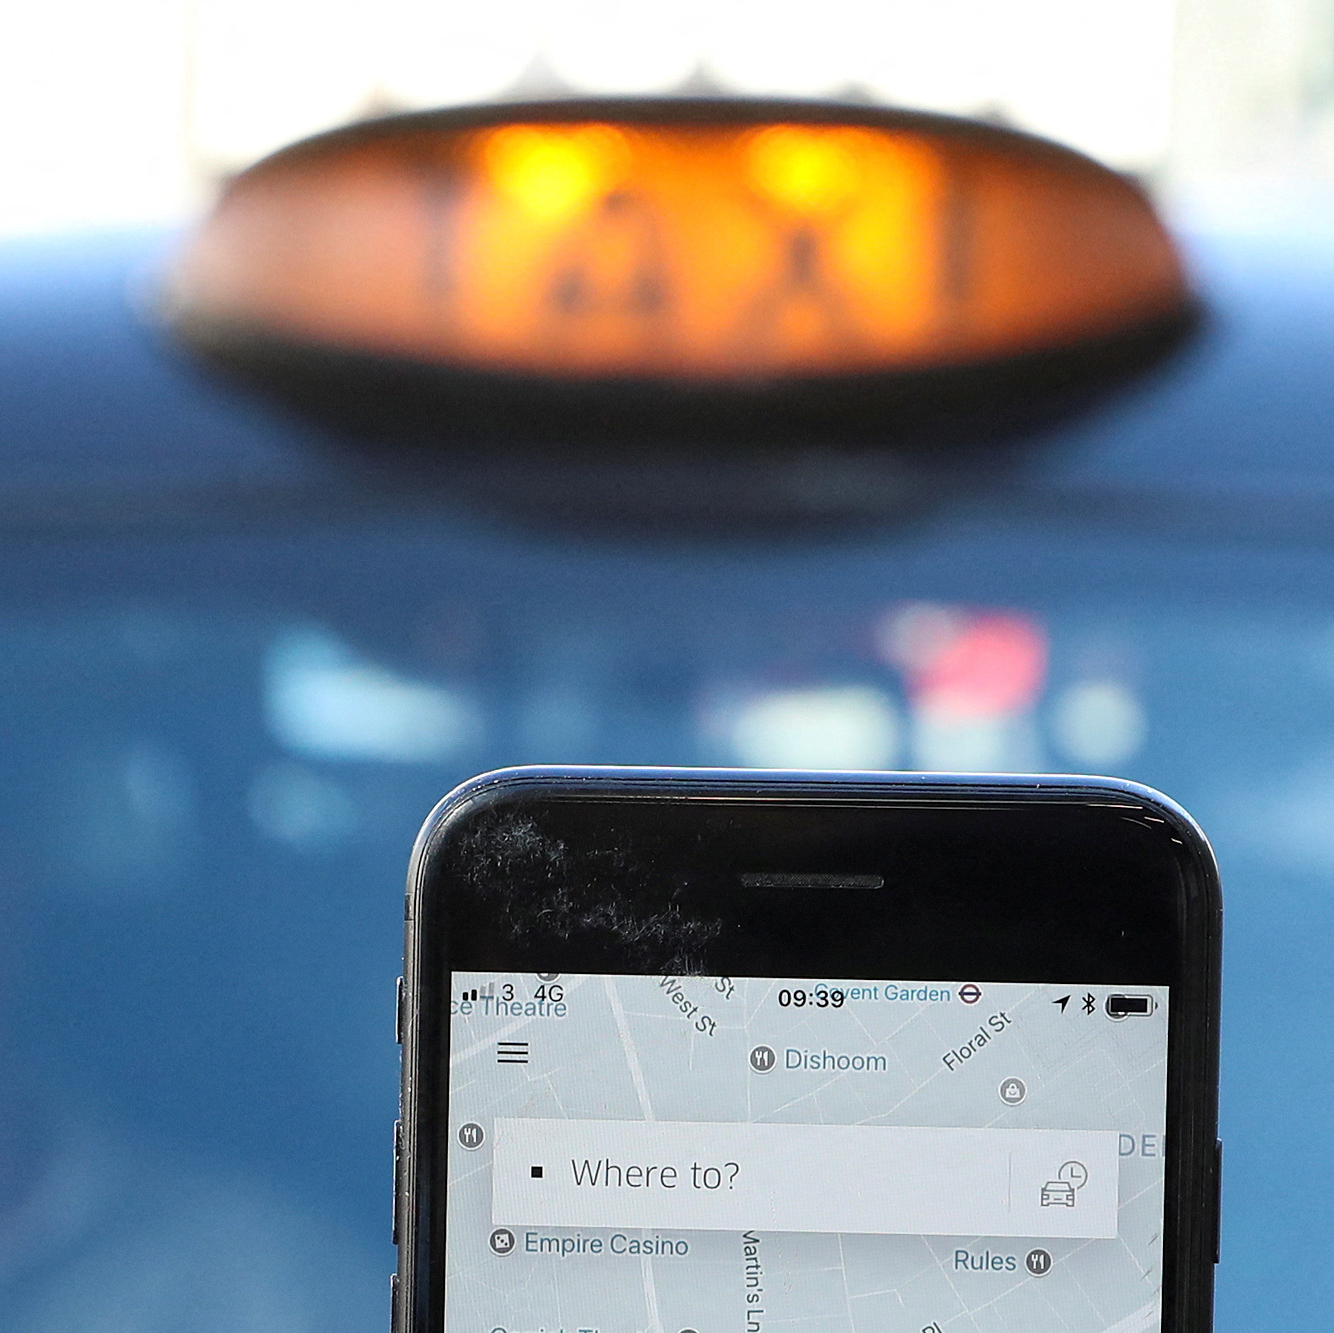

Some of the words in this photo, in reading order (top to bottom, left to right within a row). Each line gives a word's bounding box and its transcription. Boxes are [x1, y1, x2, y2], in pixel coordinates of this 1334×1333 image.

[502, 983, 514, 1001] 3
[534, 985, 564, 1002] 4G
[714, 976, 734, 1000] St
[778, 989, 845, 1008] 09:39
[884, 985, 951, 1001] Garden
[480, 996, 567, 1017] Theatre
[659, 976, 699, 1019] West
[695, 1015, 717, 1037] St
[942, 1027, 990, 1072] Floral
[988, 1010, 1013, 1034] St
[785, 1049, 888, 1072] Dishoom
[1118, 1134, 1165, 1157] DE
[571, 1158, 678, 1189] Where
[690, 1161, 740, 1190] to?
[524, 1232, 603, 1257] Empire
[610, 1234, 689, 1256] Casino
[954, 1250, 1017, 1271] Rules
[747, 1309, 764, 1333] Ln
